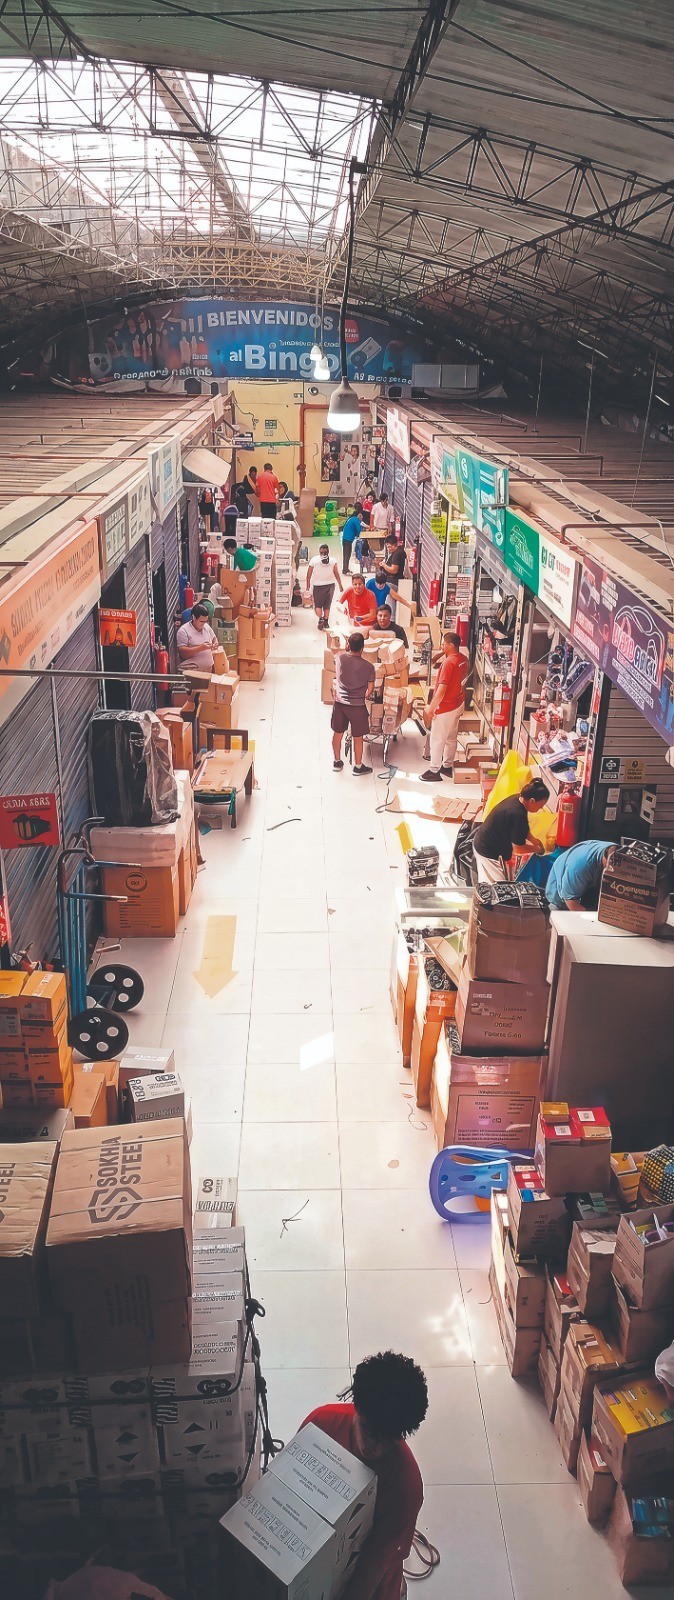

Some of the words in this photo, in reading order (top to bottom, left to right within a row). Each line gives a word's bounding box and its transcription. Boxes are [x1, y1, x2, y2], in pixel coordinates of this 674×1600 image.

[207, 310, 334, 331] BIENVENIDOS
[229, 349, 242, 362] al
[97, 1136, 121, 1187] SOKHA
